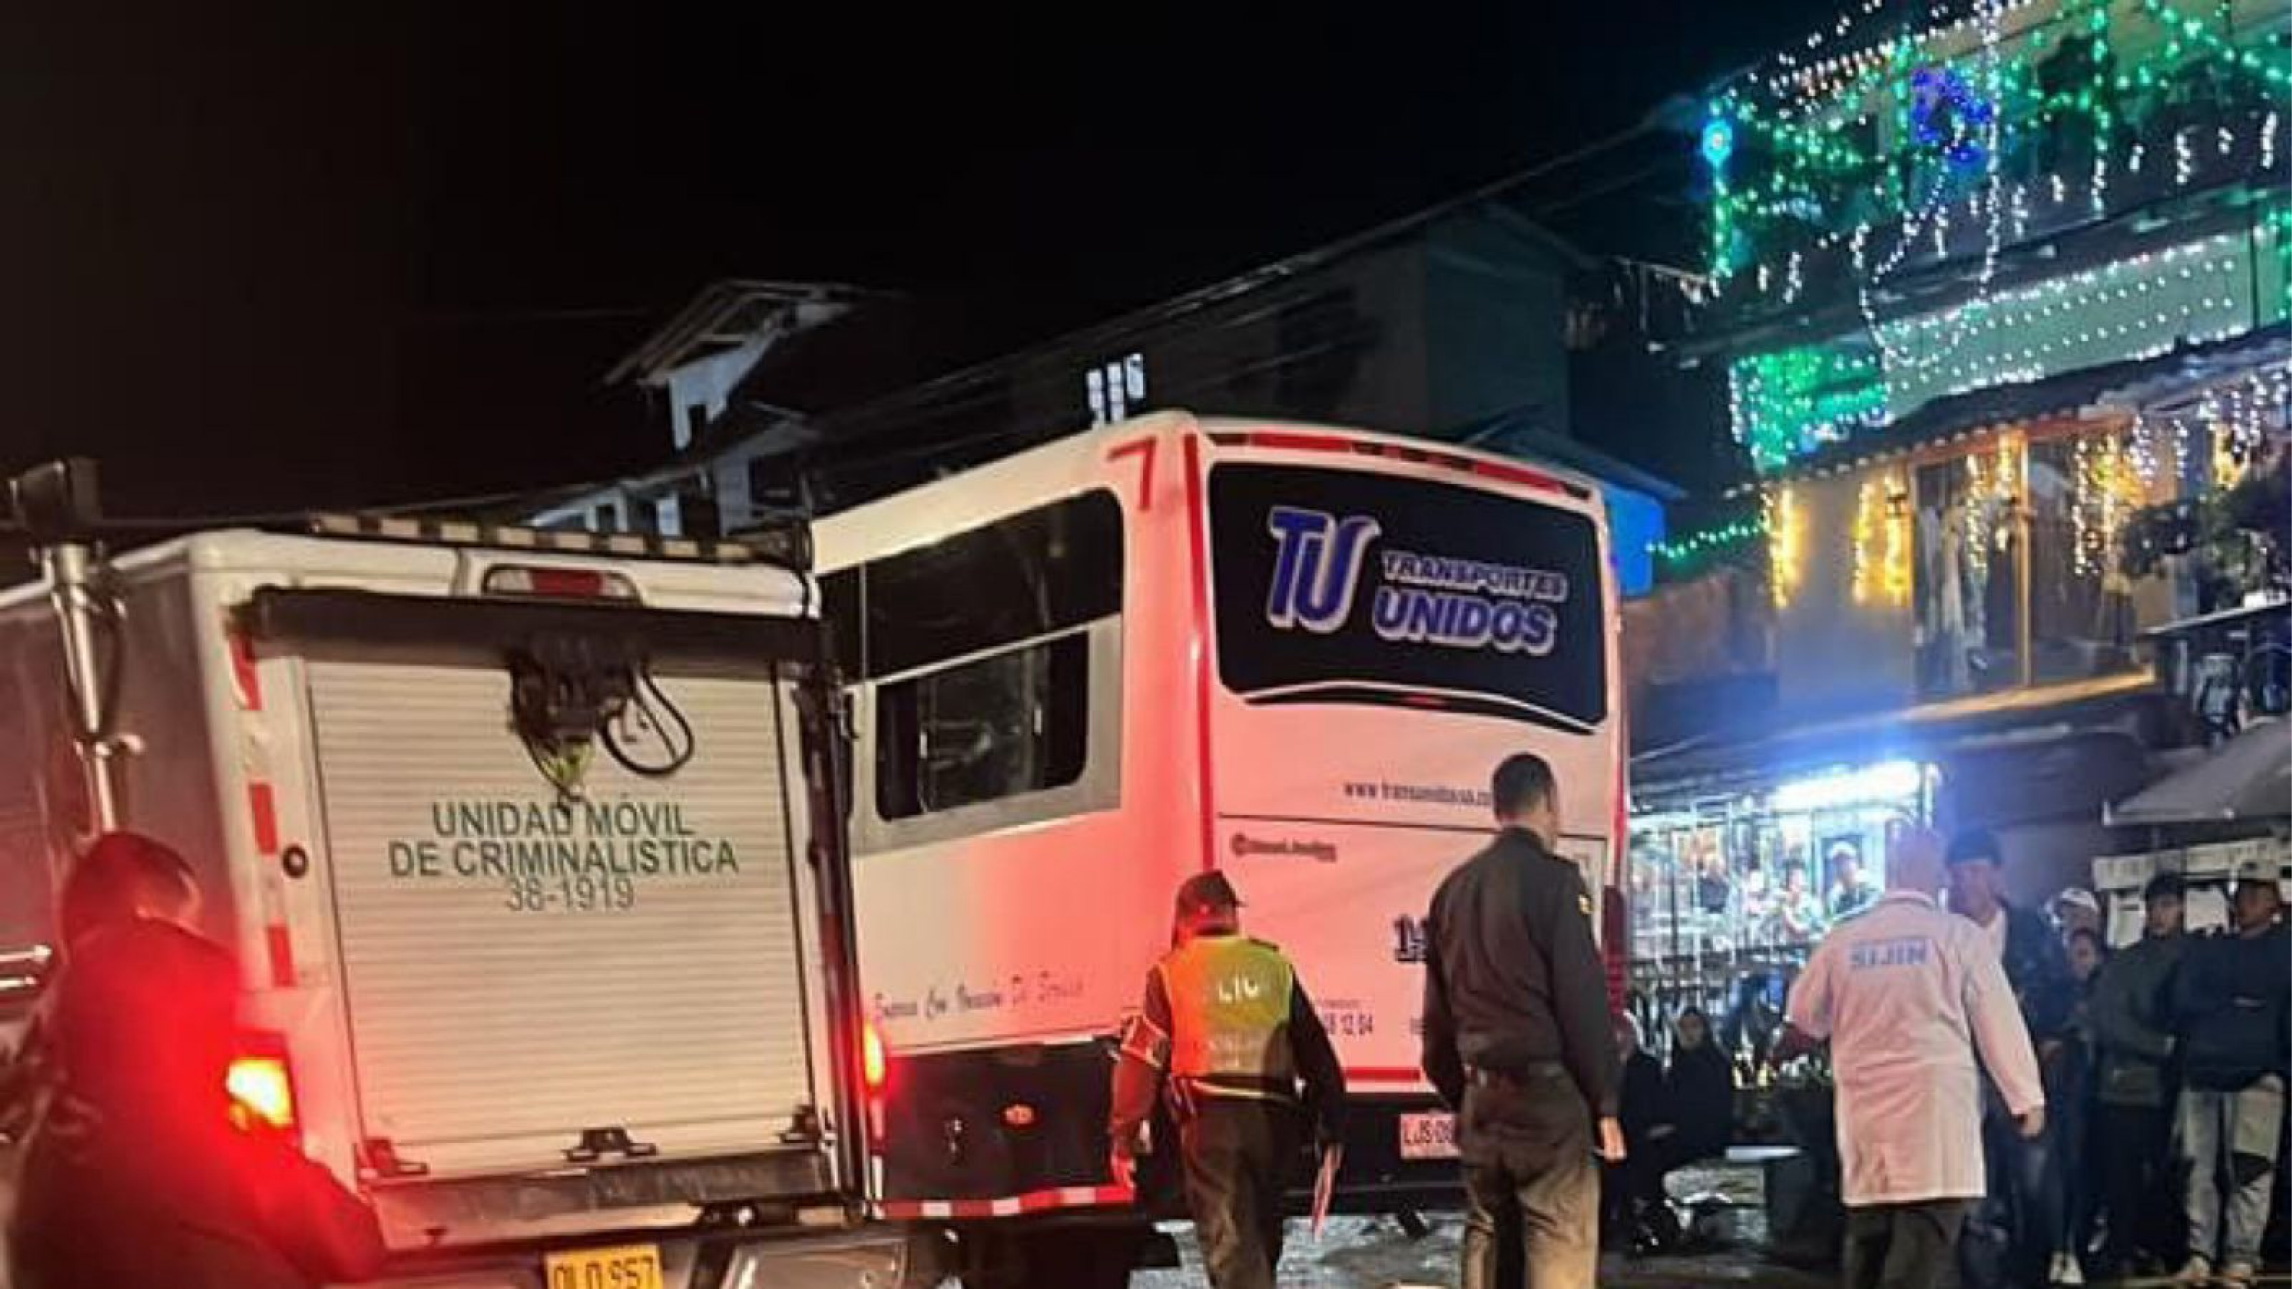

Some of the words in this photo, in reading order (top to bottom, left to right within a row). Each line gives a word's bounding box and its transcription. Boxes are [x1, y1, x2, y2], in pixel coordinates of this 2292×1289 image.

[1267, 506, 1382, 633] TU
[1381, 550, 1568, 602] TRANSPORTES
[1372, 586, 1558, 656] UNIDOS
[431, 800, 574, 837] UNIDAD
[388, 841, 442, 877] DE
[506, 876, 637, 913] 38-1919
[1851, 938, 1929, 969] SIJIN
